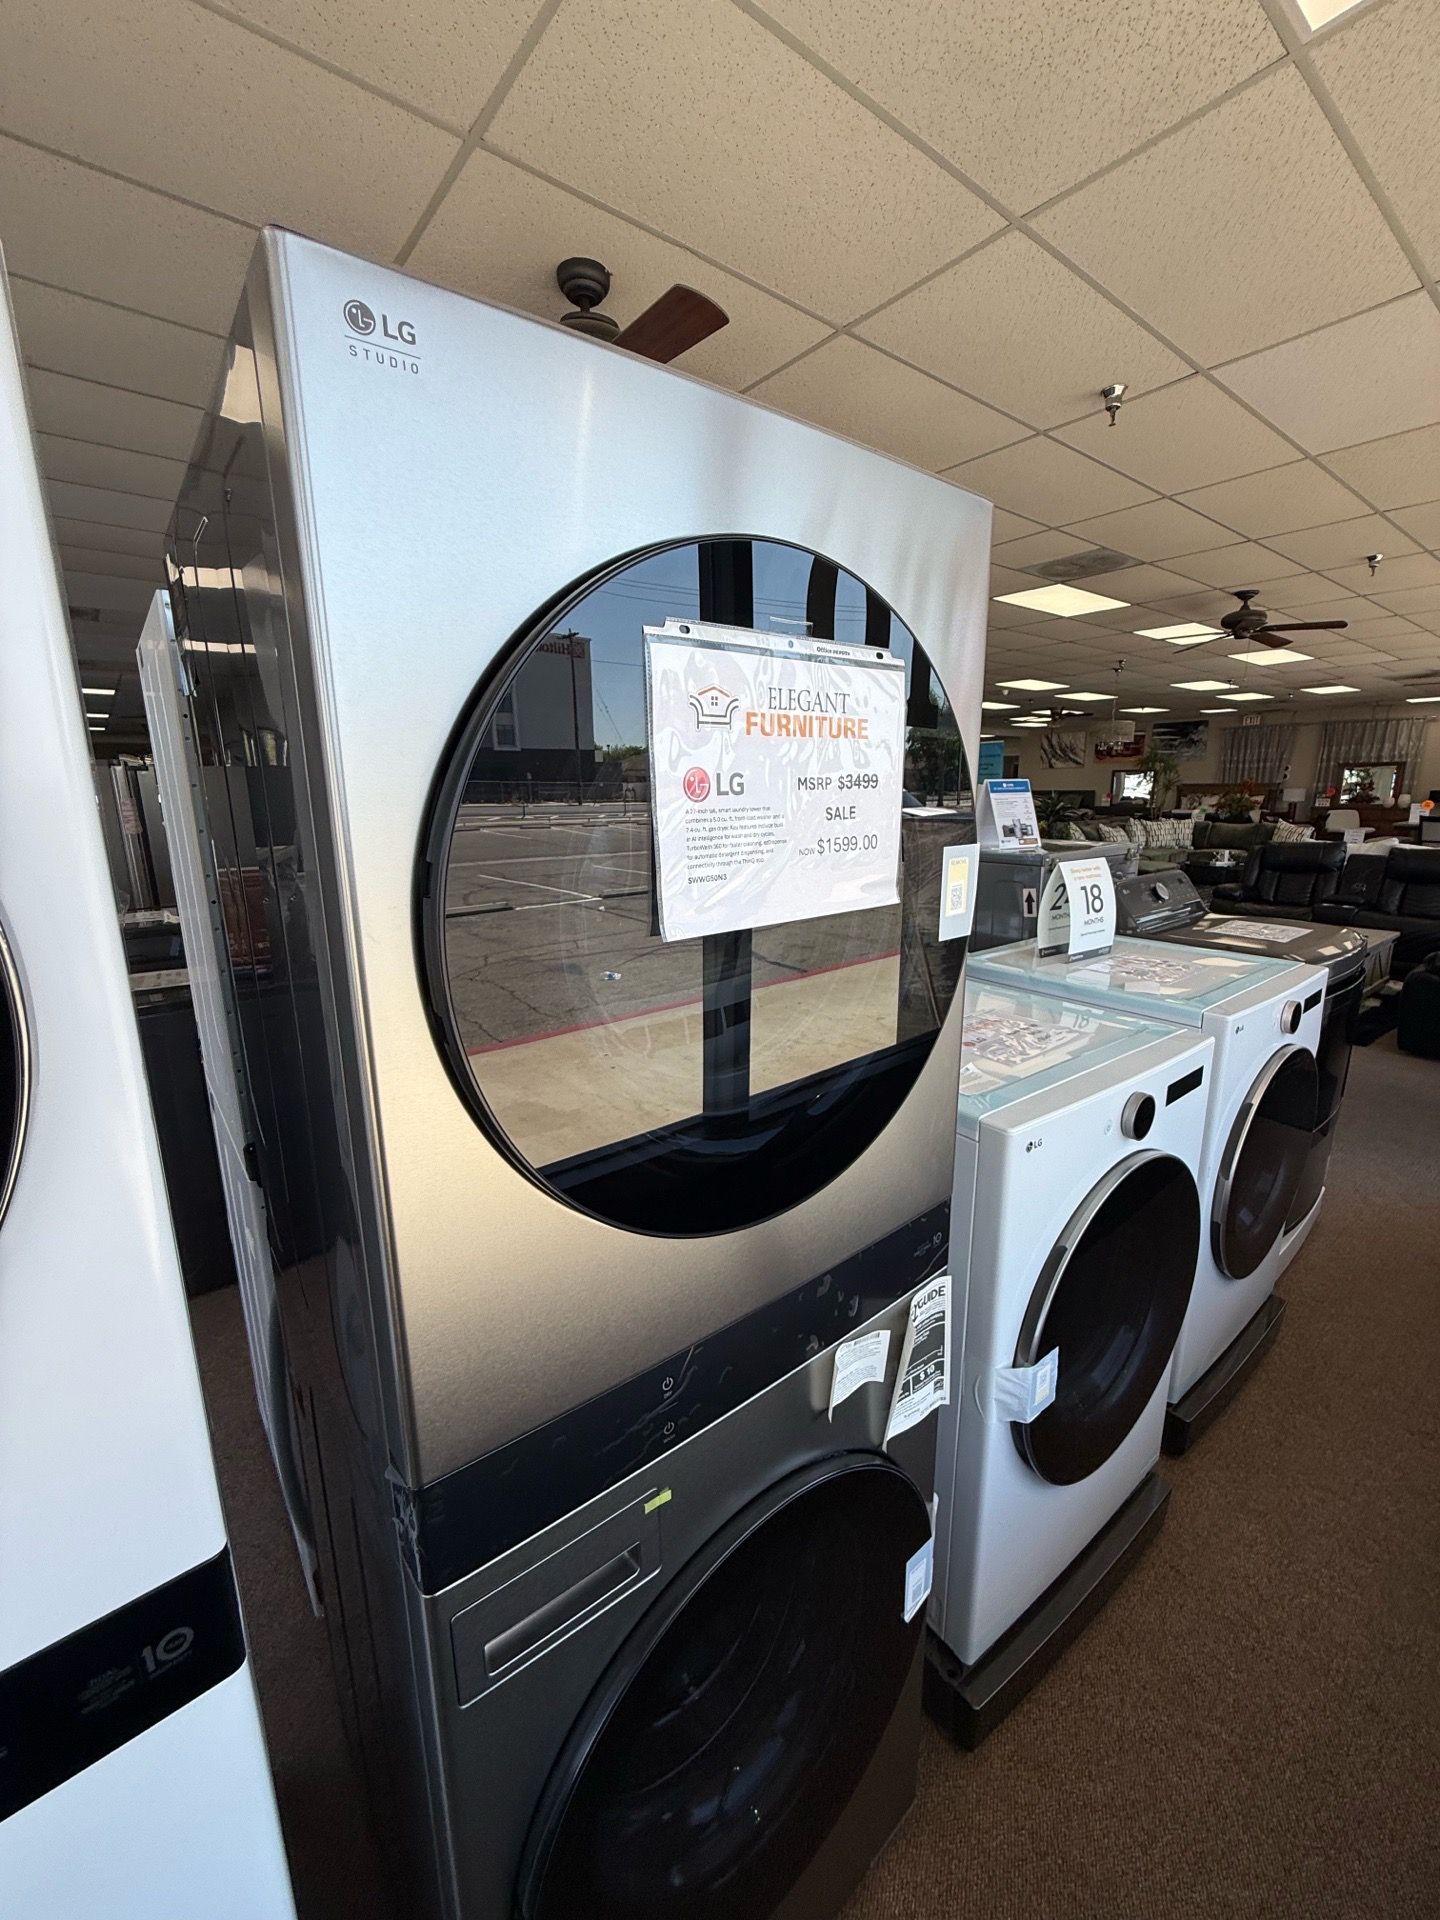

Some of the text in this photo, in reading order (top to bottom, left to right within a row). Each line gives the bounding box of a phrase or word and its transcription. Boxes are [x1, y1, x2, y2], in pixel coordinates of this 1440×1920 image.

[381, 314, 417, 346] LG
[349, 345, 420, 375] STUDIO
[768, 687, 851, 714] ELEGANT
[745, 711, 869, 740] FURNITURE
[716, 772, 745, 796] LG
[797, 773, 879, 792] MSRP $3499
[825, 805, 857, 821] SALE
[697, 834, 723, 842] intelligence
[798, 833, 878, 856] NOW $1599.00
[1049, 882, 1070, 911] 2
[1080, 883, 1104, 915] 18
[1083, 916, 1104, 926] MONTHS
[140, 1626, 195, 1674] 10
